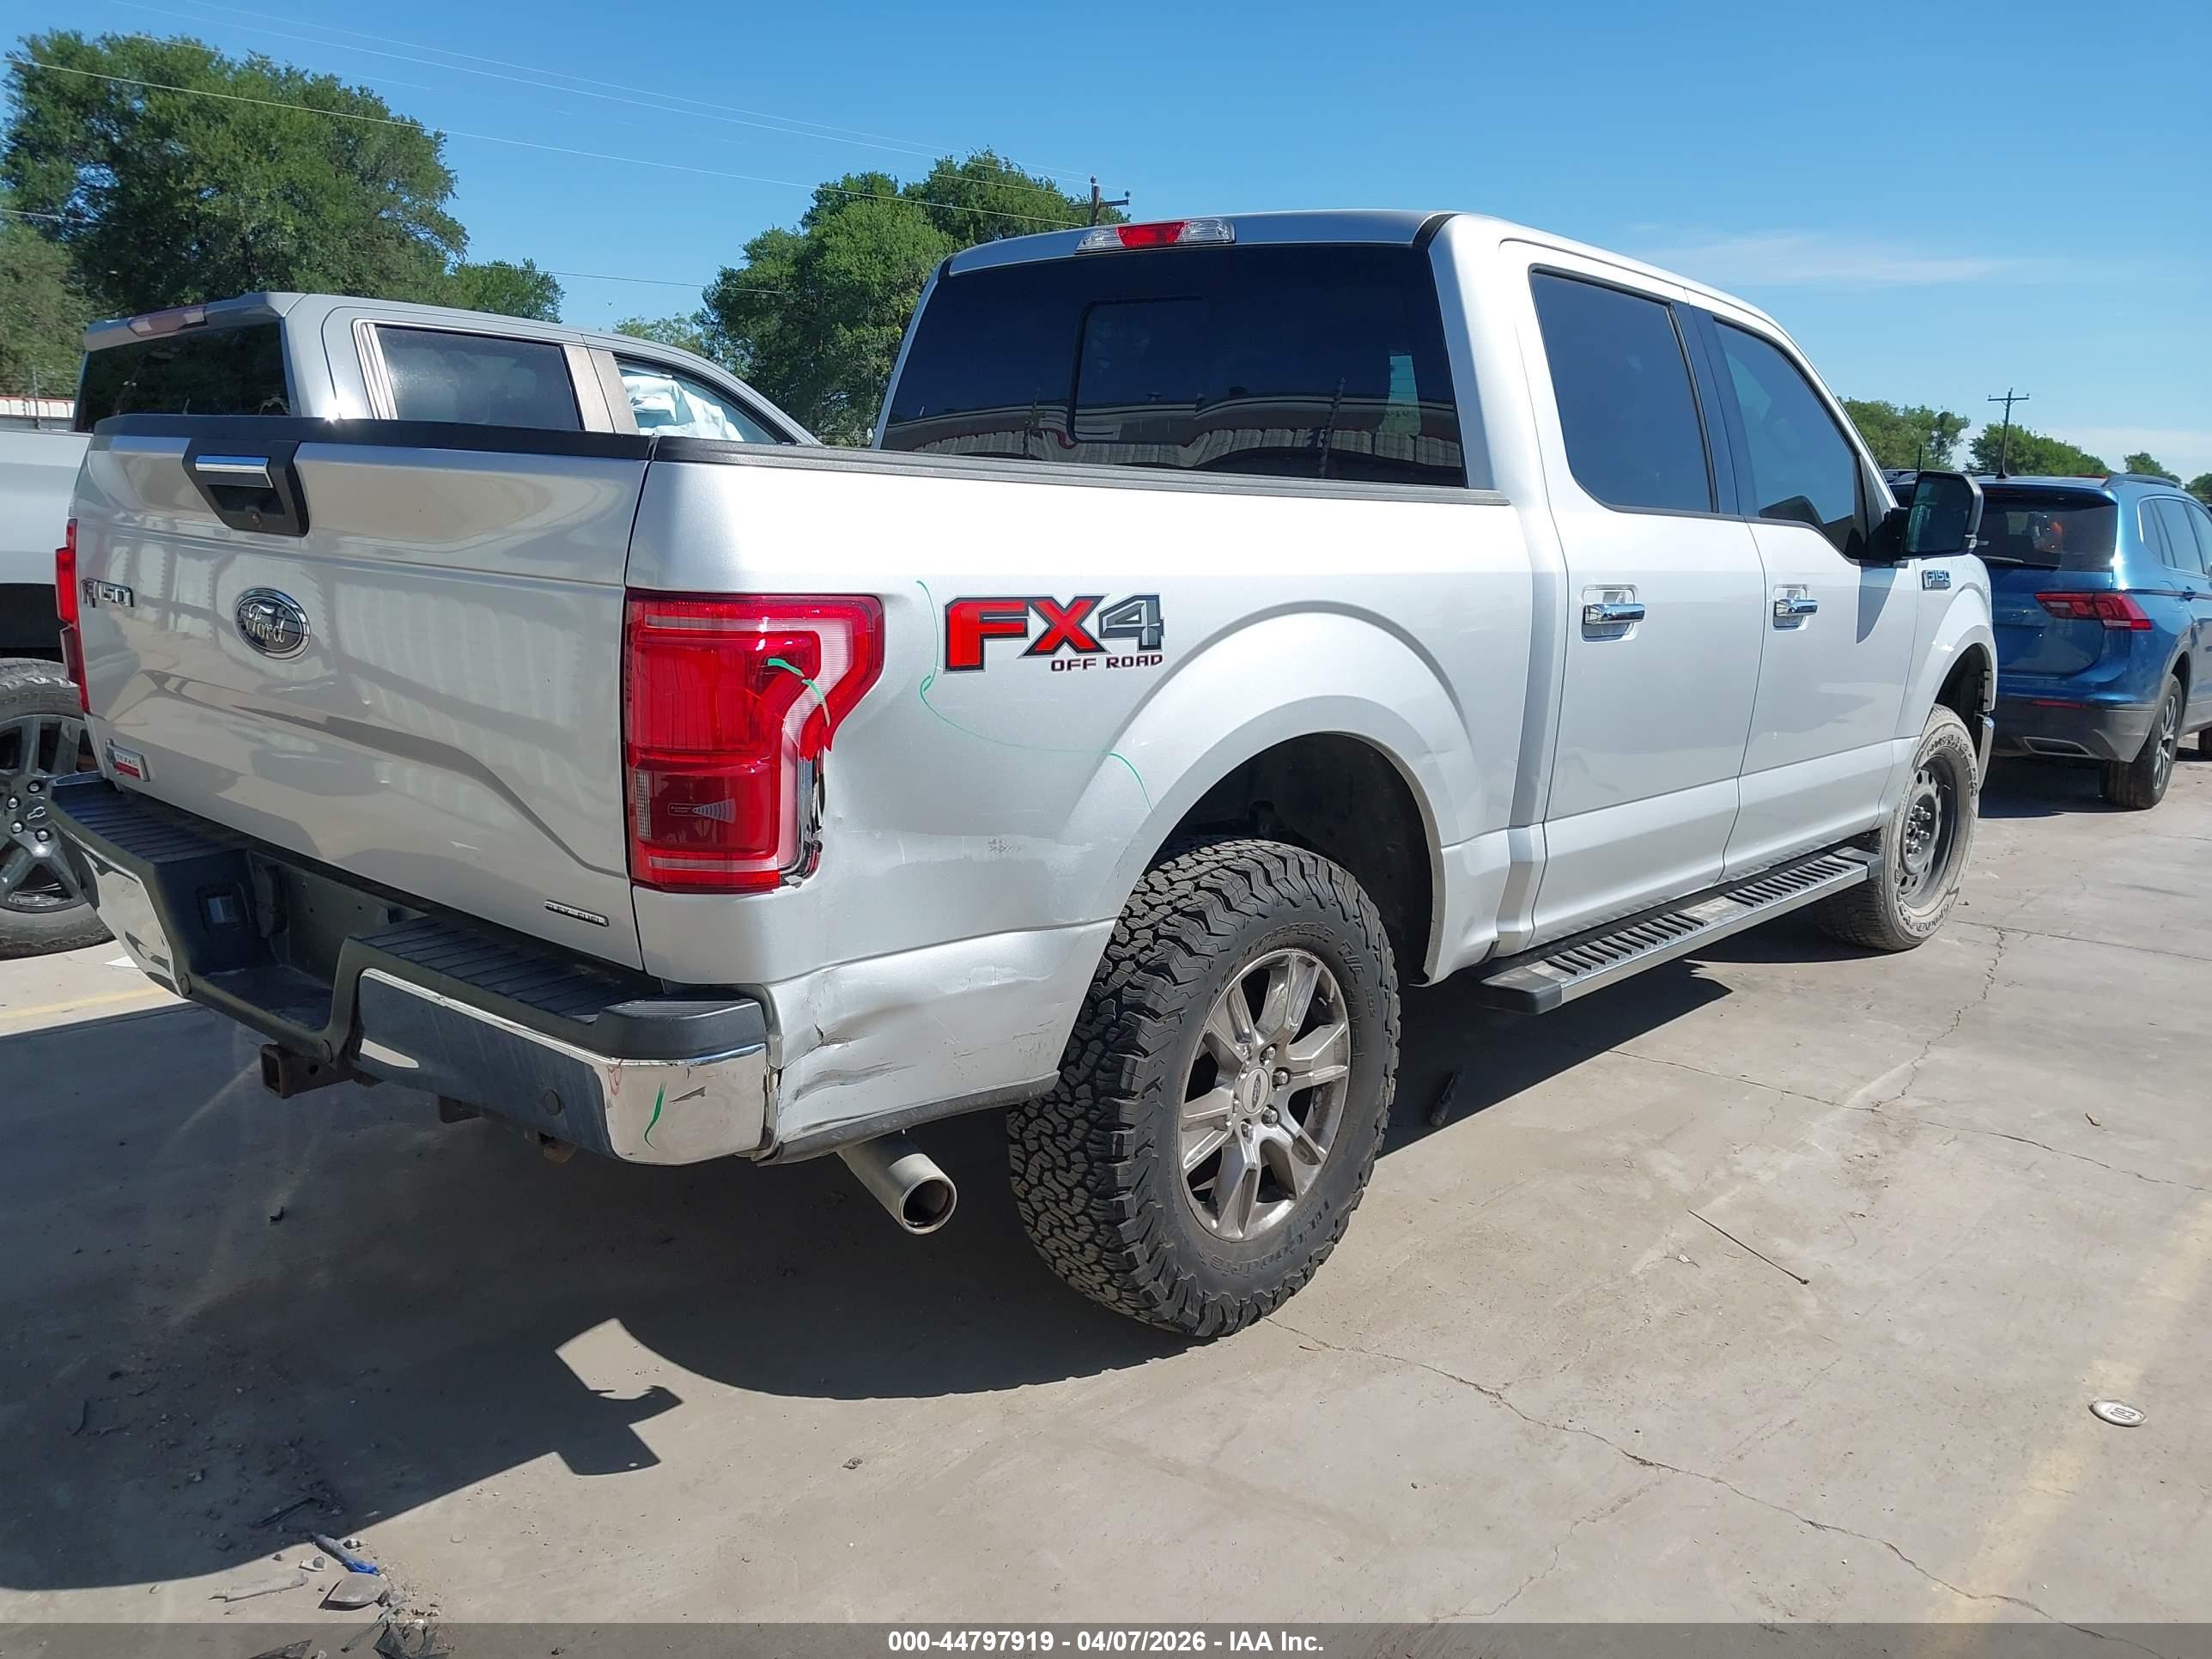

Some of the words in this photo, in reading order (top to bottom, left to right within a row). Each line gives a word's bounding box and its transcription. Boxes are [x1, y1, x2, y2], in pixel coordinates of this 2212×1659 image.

[246, 603, 286, 643] Ford
[944, 592, 1164, 674] FX4
[1051, 659, 1097, 672] OFF
[1106, 654, 1163, 669] ROAD
